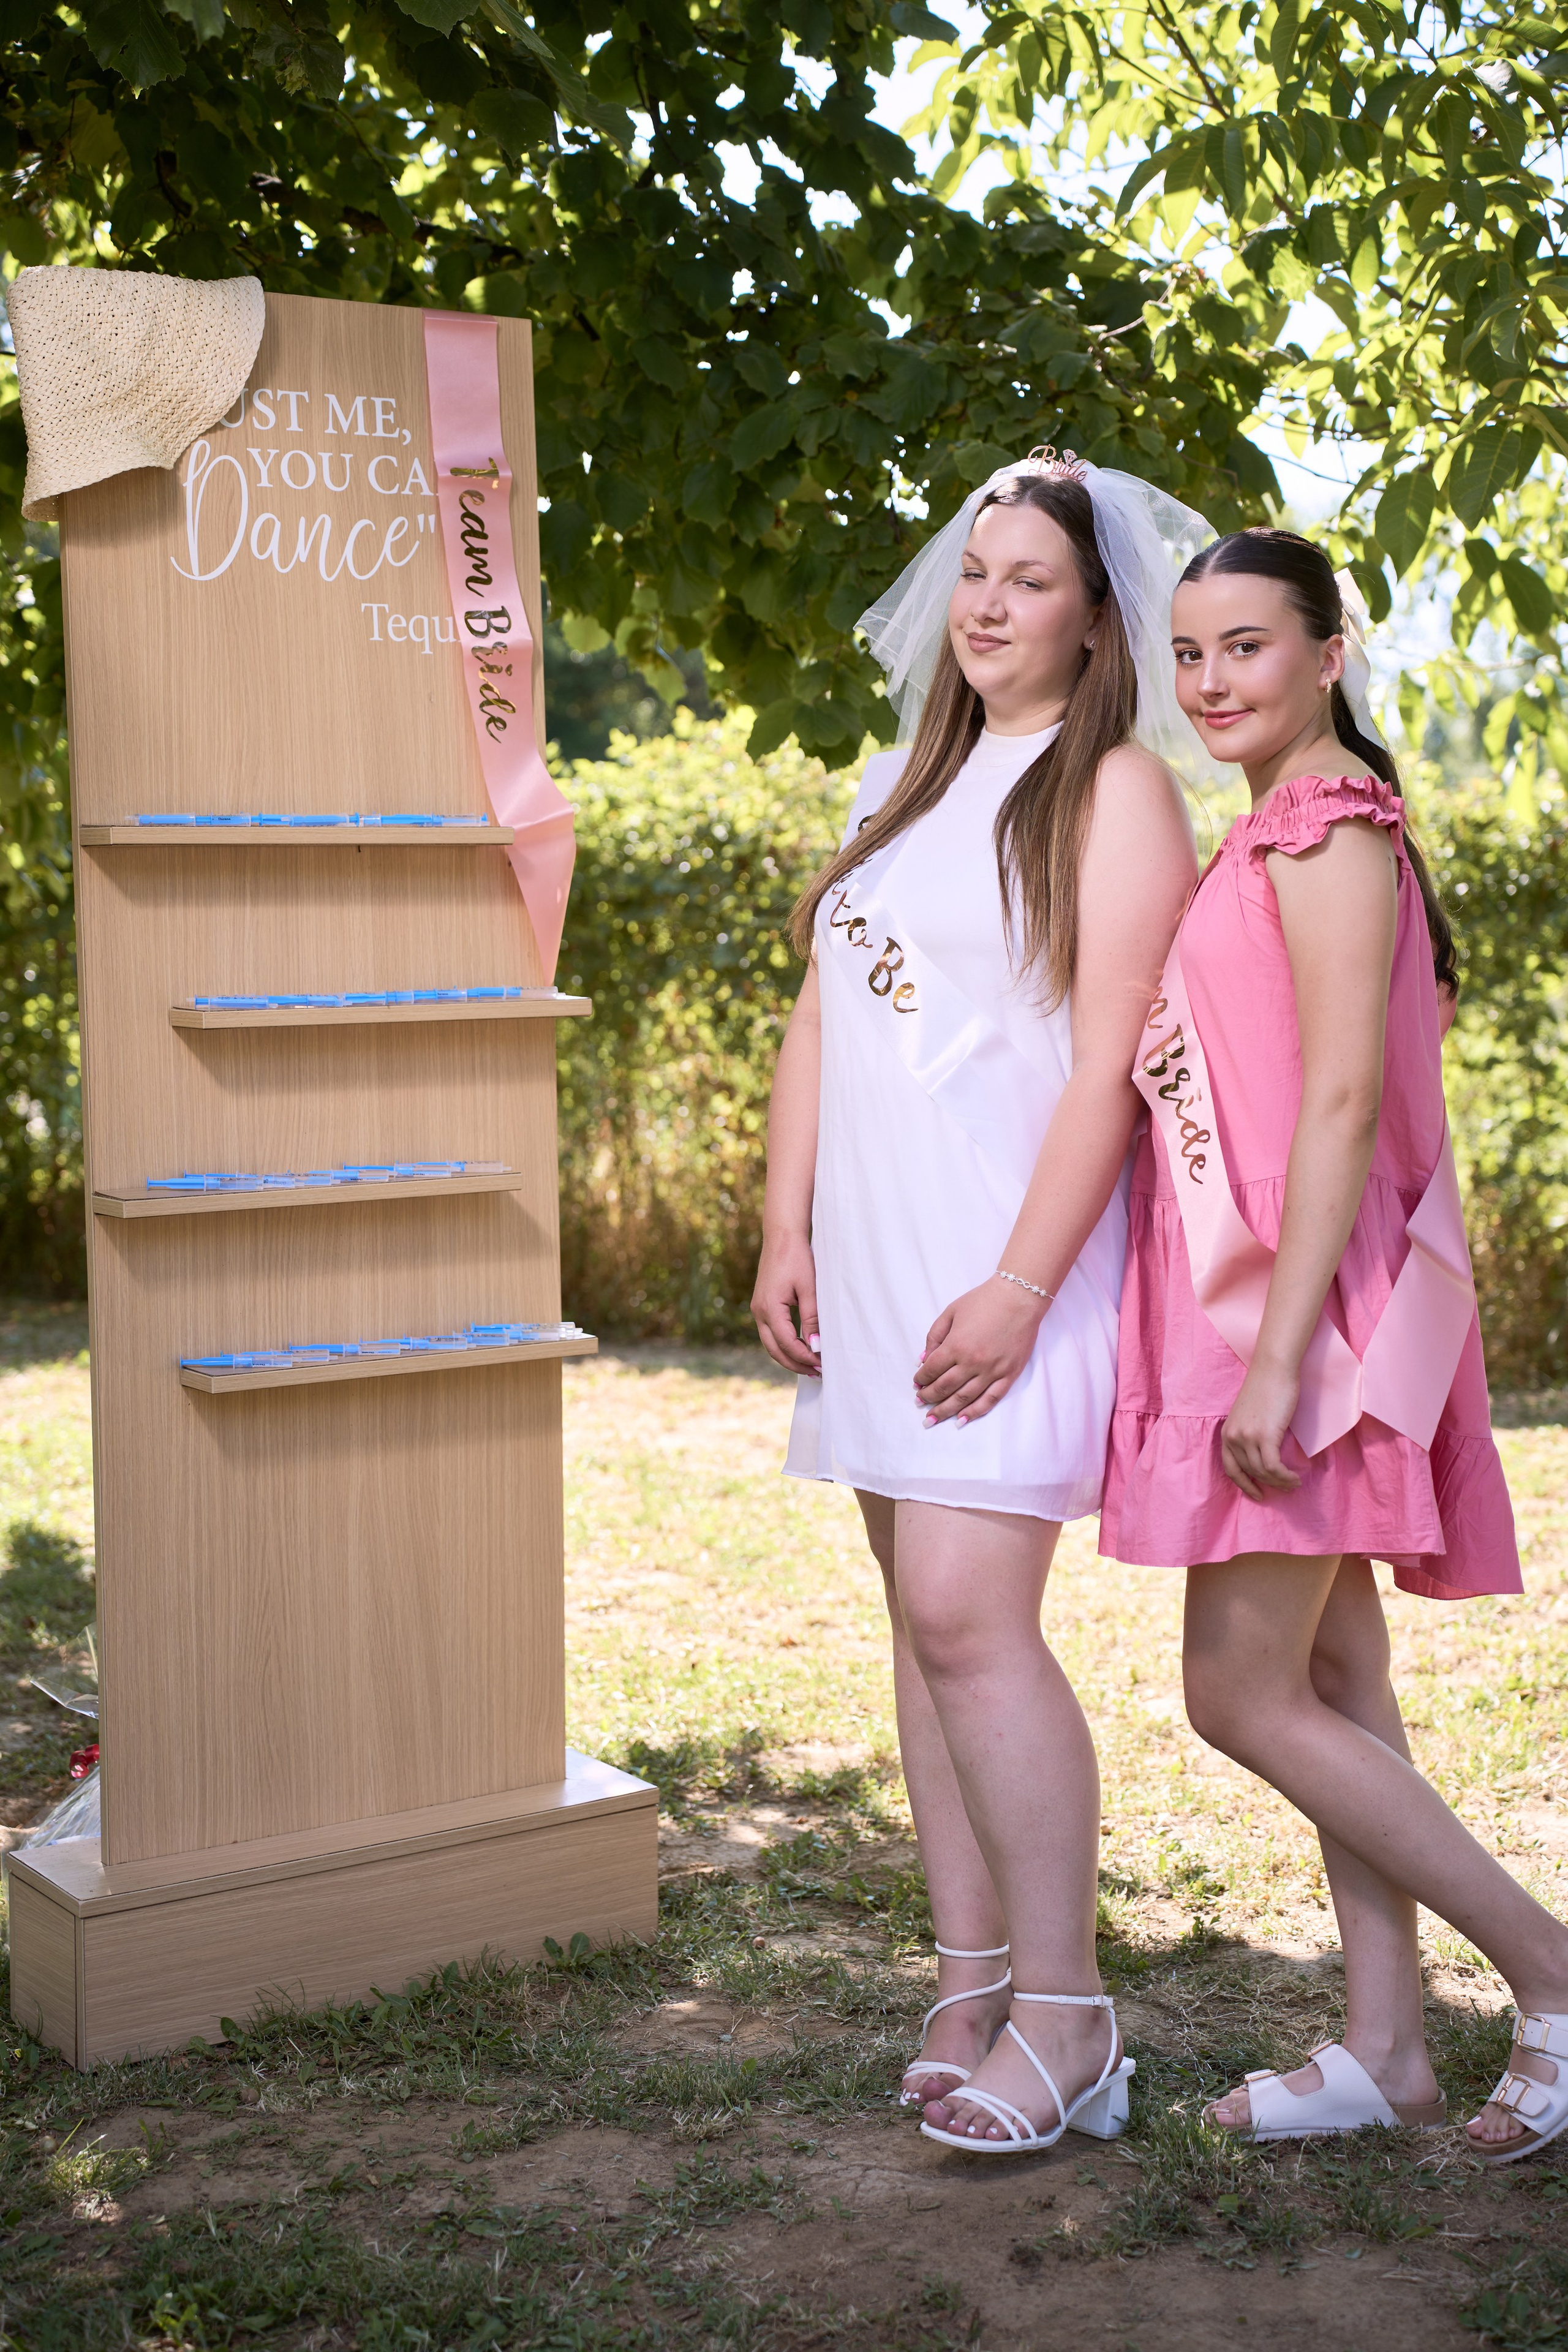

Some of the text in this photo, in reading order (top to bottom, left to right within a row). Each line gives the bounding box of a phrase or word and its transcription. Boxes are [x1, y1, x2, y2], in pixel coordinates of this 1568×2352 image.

[219, 388, 412, 446] UST ME,
[1028, 444, 1088, 481] Bride
[170, 439, 435, 582] Dance"
[246, 448, 439, 497] YOU CA
[361, 603, 462, 655] Tequ
[450, 457, 516, 744] Team Bride
[830, 889, 873, 949] to
[868, 937, 919, 1014] Be
[1142, 1023, 1210, 1185] Bride
